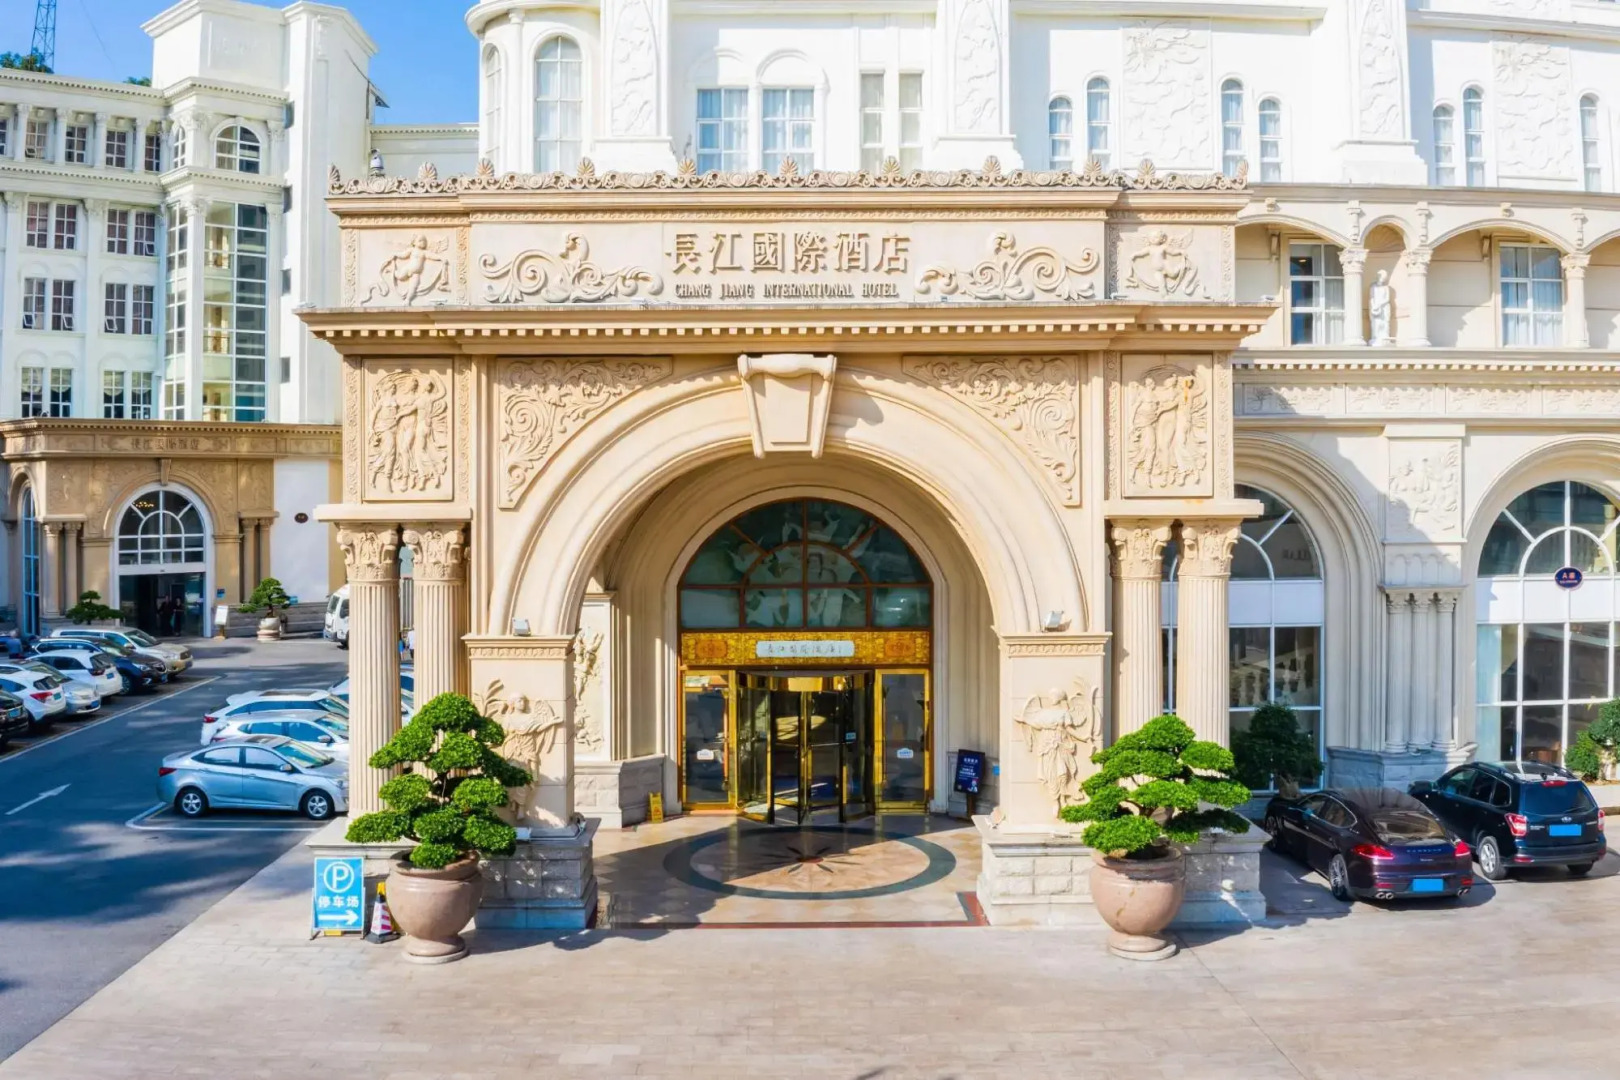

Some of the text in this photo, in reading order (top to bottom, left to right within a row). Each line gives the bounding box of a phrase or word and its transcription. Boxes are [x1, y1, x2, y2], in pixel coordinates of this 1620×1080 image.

[666, 231, 911, 274] 長江國際酒店
[674, 283, 899, 299] CHANG JIANG INTERNATIONAL HOTEL
[332, 866, 350, 890] P
[318, 895, 359, 908] 停车场
